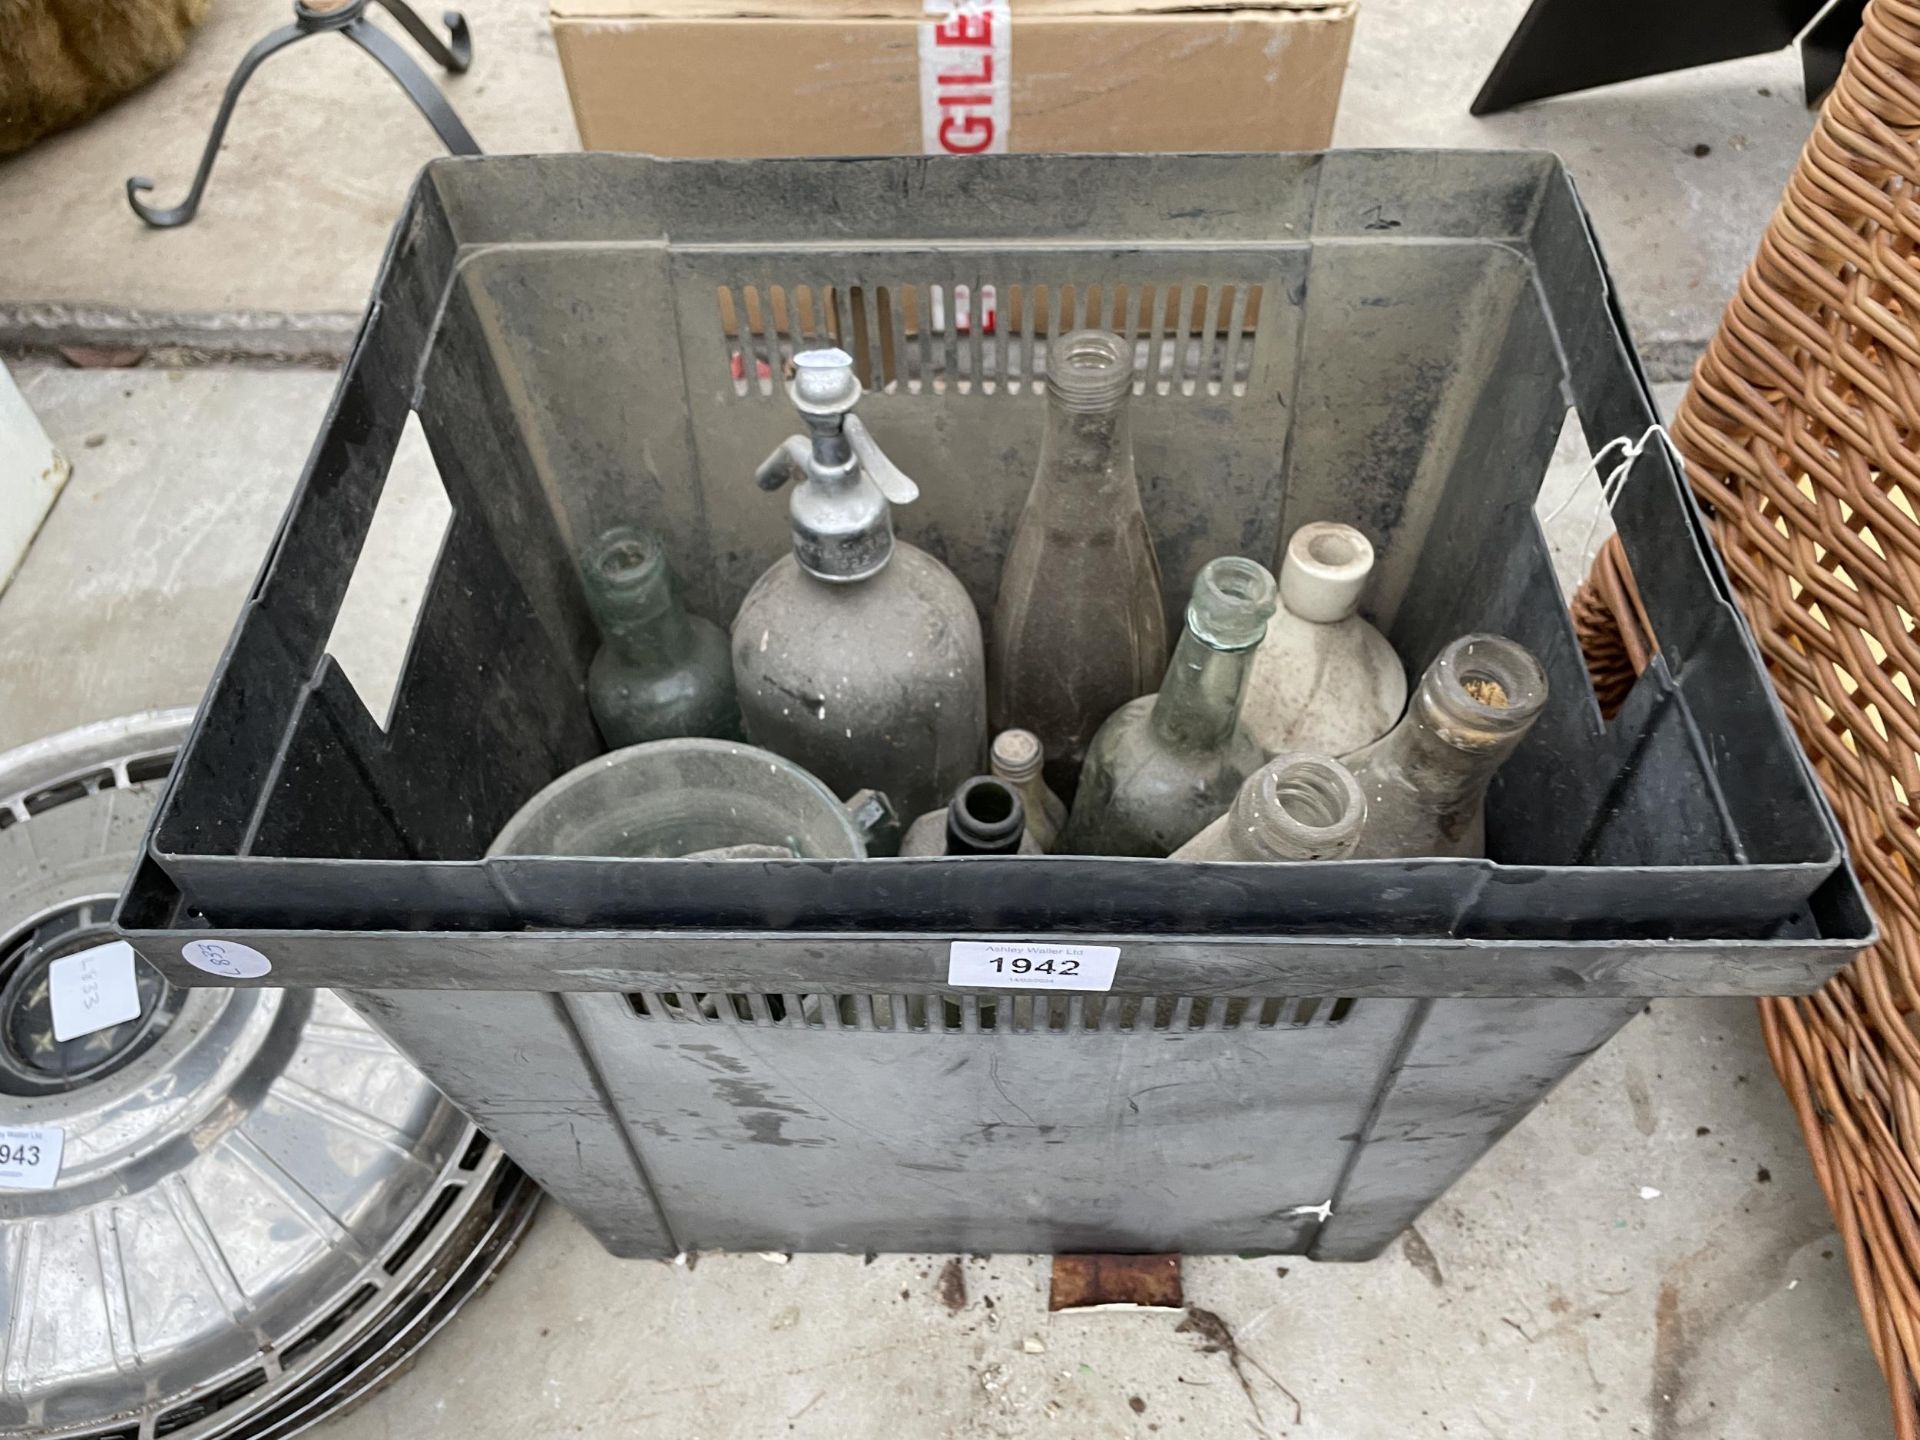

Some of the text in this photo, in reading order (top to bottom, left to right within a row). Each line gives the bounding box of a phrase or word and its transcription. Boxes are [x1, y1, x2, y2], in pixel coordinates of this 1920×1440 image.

[198, 943, 241, 976] L833
[986, 946, 1023, 955] Ashley
[1027, 947, 1063, 956] Waller
[989, 957, 1081, 976] 1942
